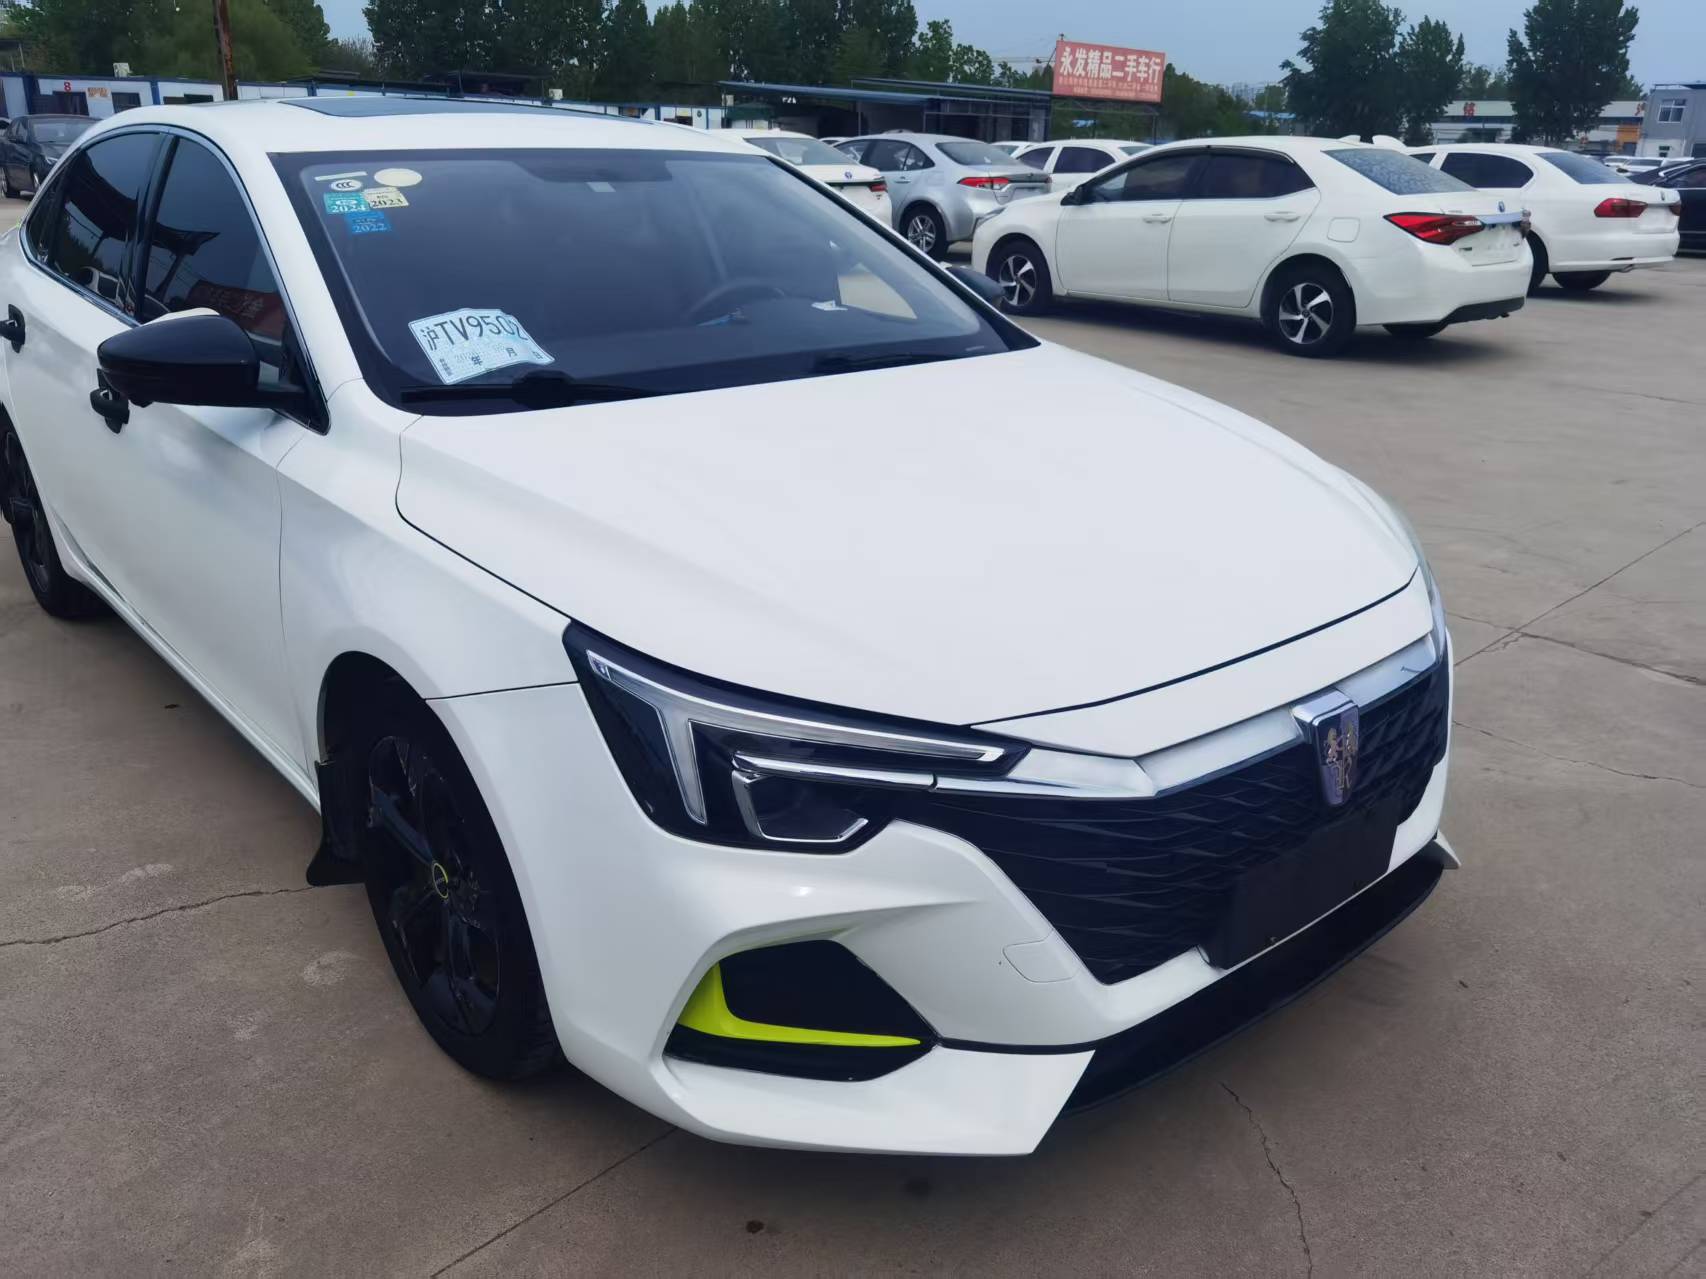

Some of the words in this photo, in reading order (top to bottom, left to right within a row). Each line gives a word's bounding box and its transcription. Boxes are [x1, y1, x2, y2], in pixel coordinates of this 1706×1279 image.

[1060, 46, 1160, 83] 永发精品二手车行
[64, 81, 71, 92] 8
[371, 198, 404, 207] 2023
[420, 315, 529, 351] 沪TV9502
